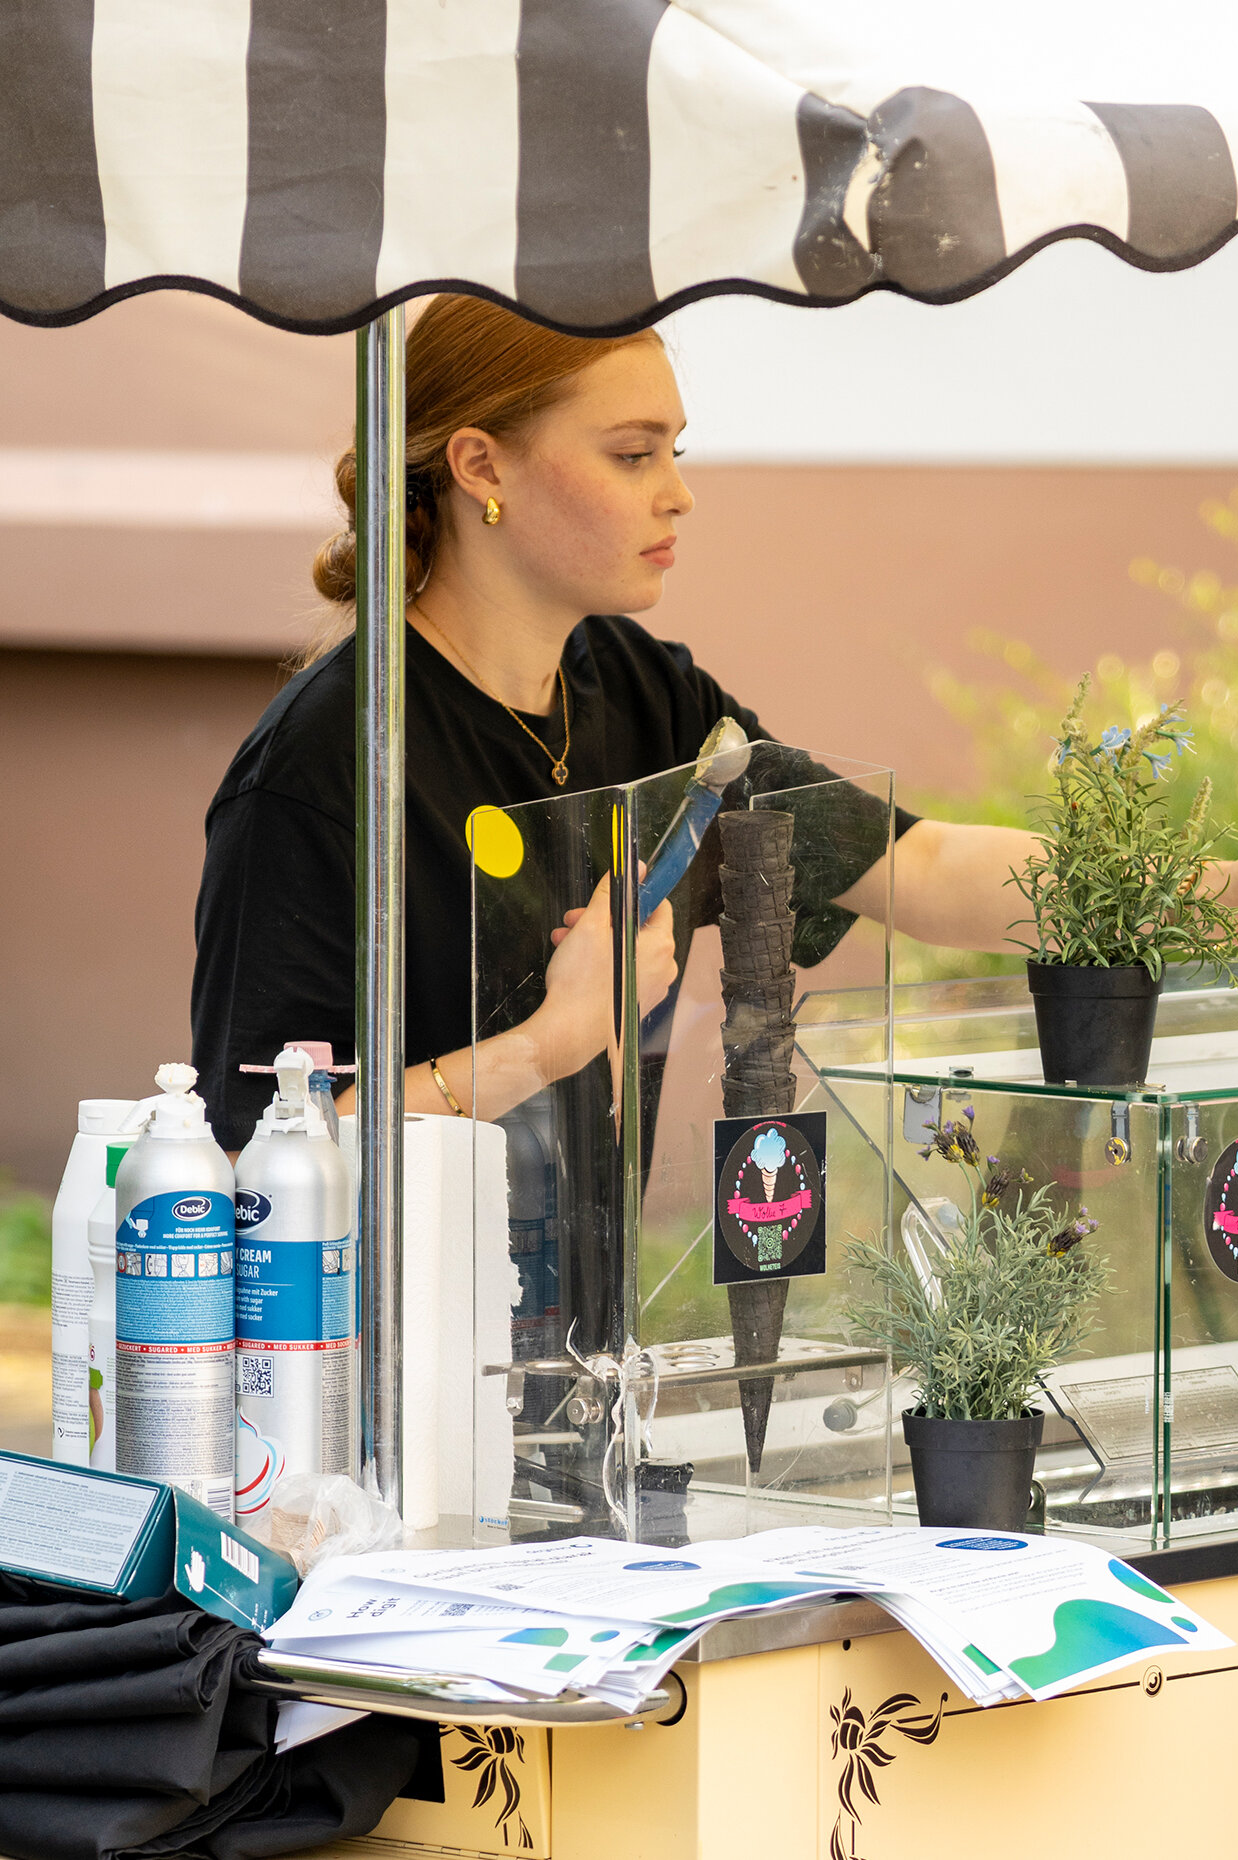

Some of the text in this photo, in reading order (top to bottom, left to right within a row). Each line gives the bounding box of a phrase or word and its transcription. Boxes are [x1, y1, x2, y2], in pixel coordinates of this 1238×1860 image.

[180, 1204, 206, 1214] Debic
[235, 1204, 259, 1221] ebic
[240, 1247, 272, 1263] CREAM
[236, 1264, 260, 1278] SUGAR
[260, 1288, 279, 1297] Zucker
[242, 1341, 266, 1350] SUGARED
[289, 1343, 315, 1351] SUKKER
